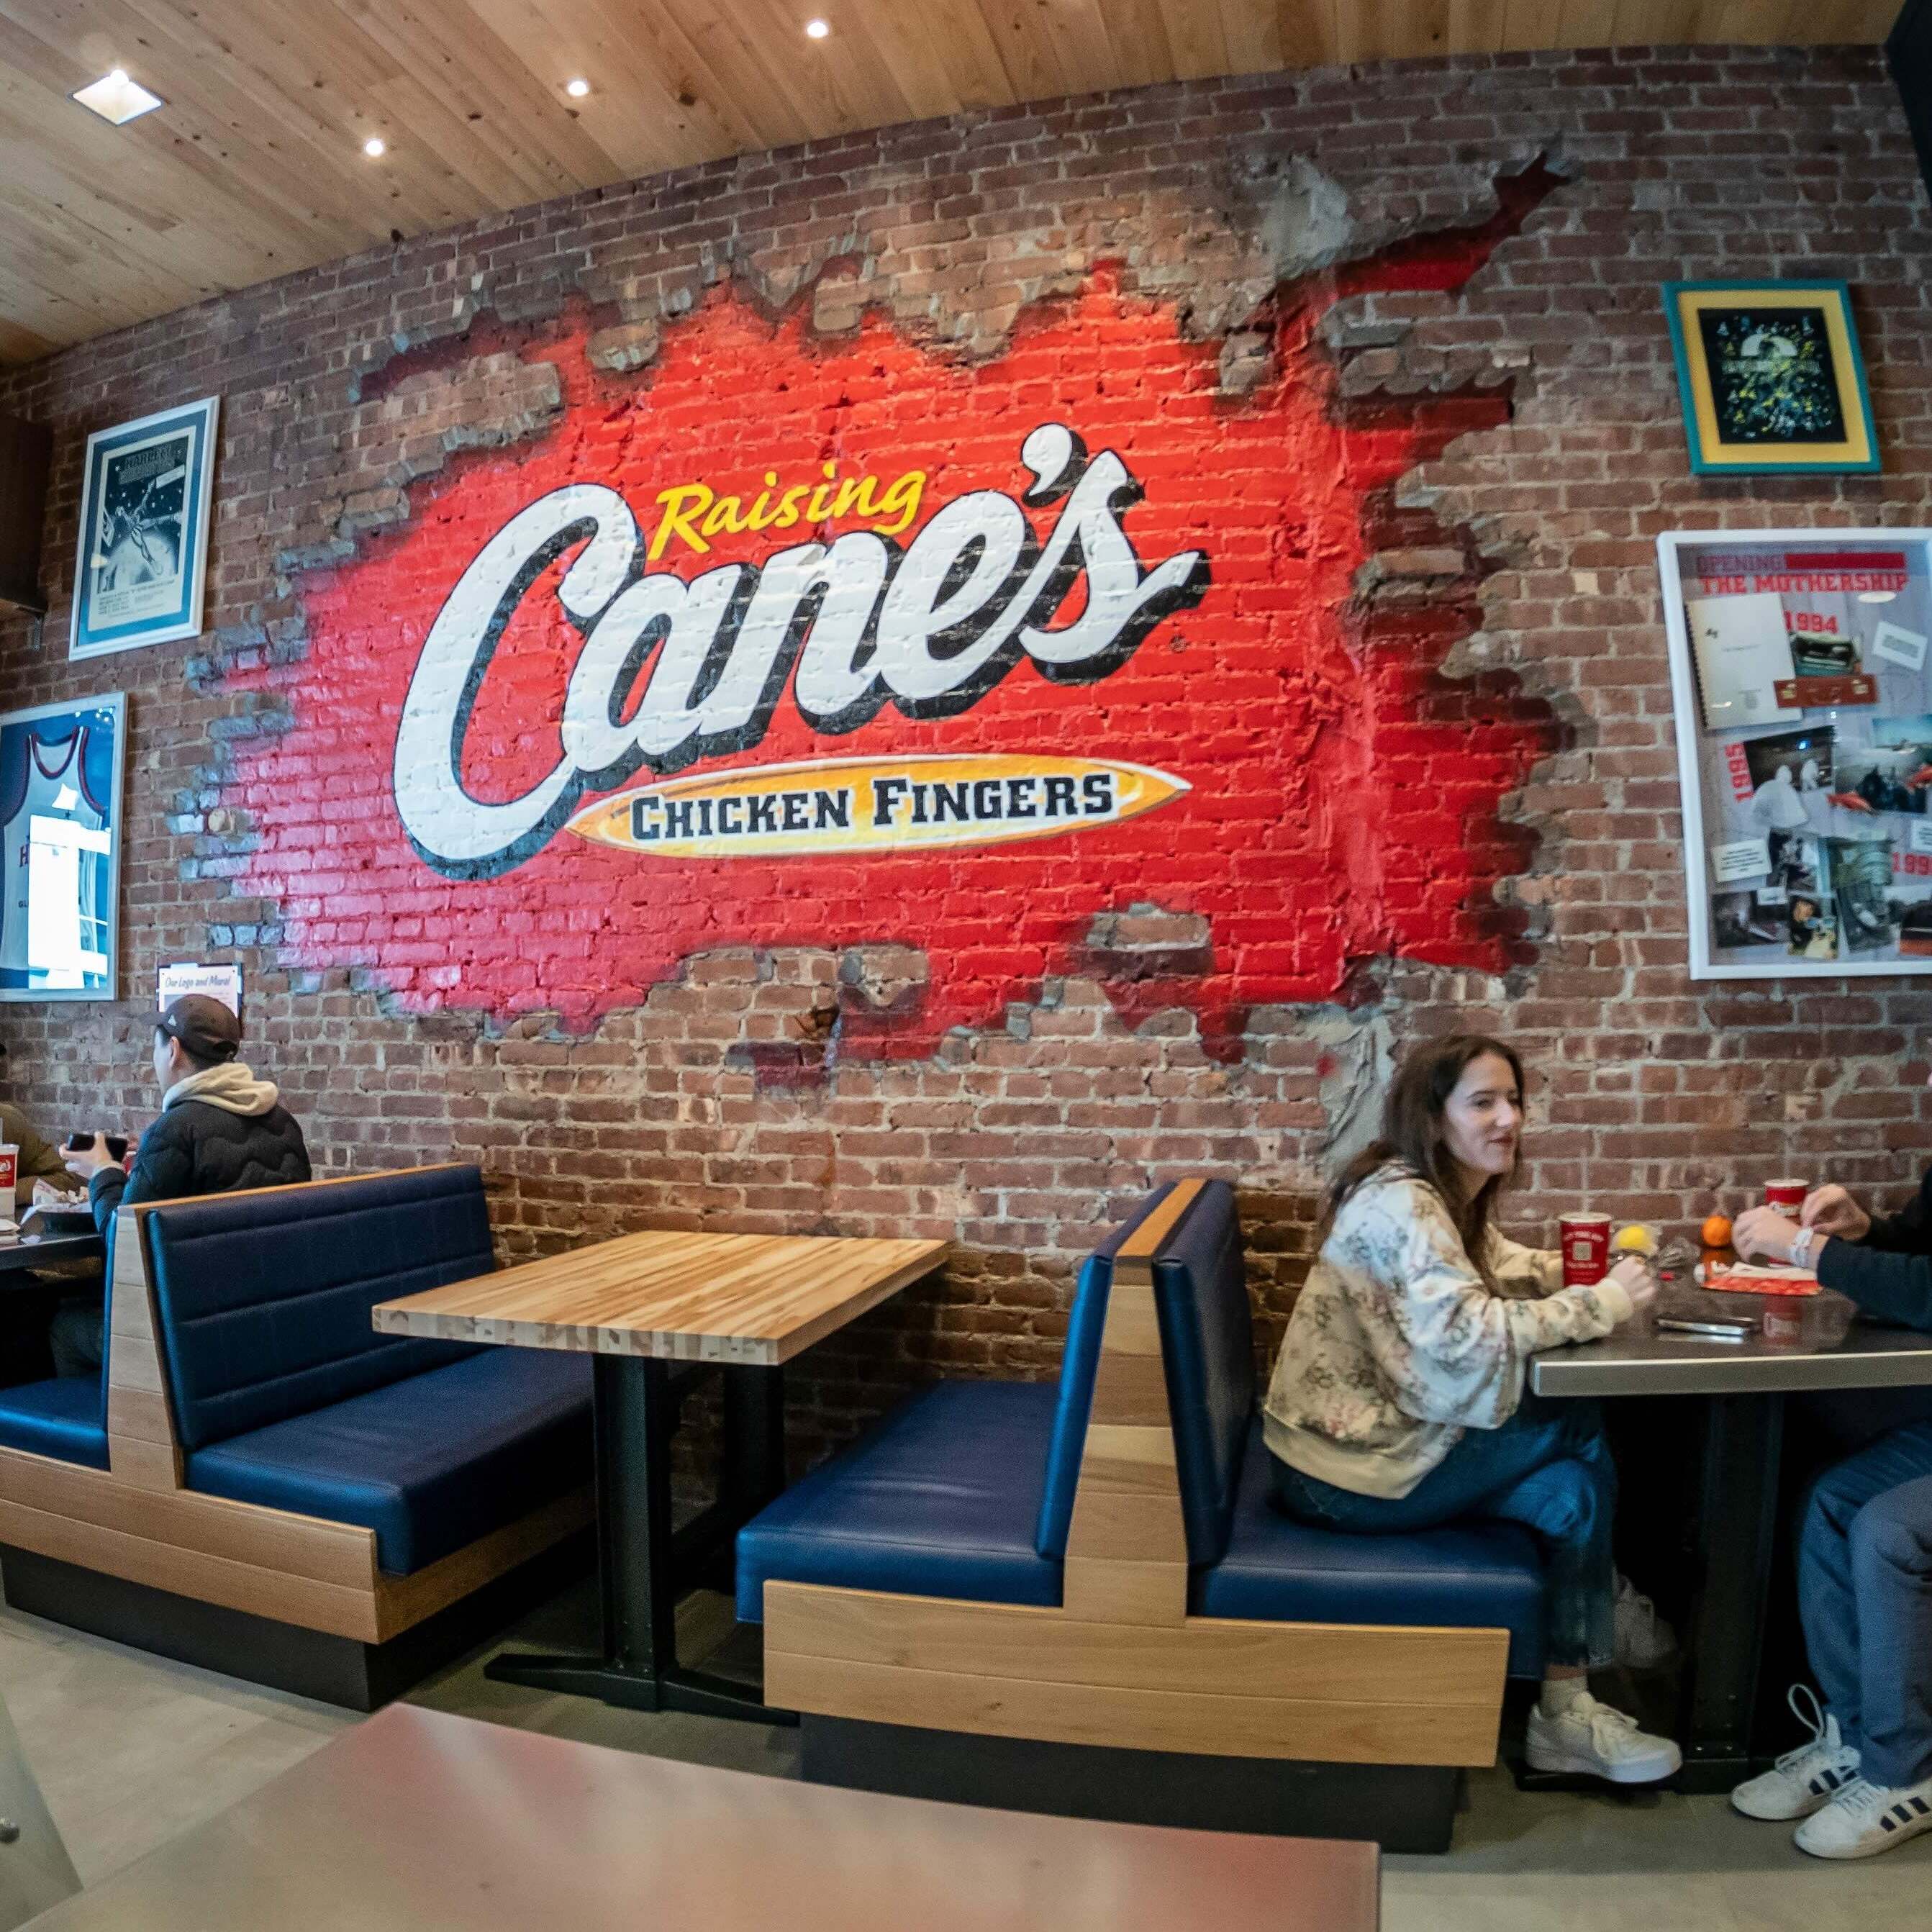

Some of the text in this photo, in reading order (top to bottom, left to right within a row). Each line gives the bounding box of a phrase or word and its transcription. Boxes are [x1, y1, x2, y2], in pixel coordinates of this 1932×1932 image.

[647, 461, 928, 561] Raising
[1700, 573, 1908, 595] THE MOTHERSHIP
[1784, 610, 1839, 634] 1994
[393, 423, 1207, 872] Cane's
[631, 774, 1115, 841] CHICKEN FINGERS
[1892, 852, 1932, 875] 199
[165, 975, 230, 989] Our Logo and Mural
